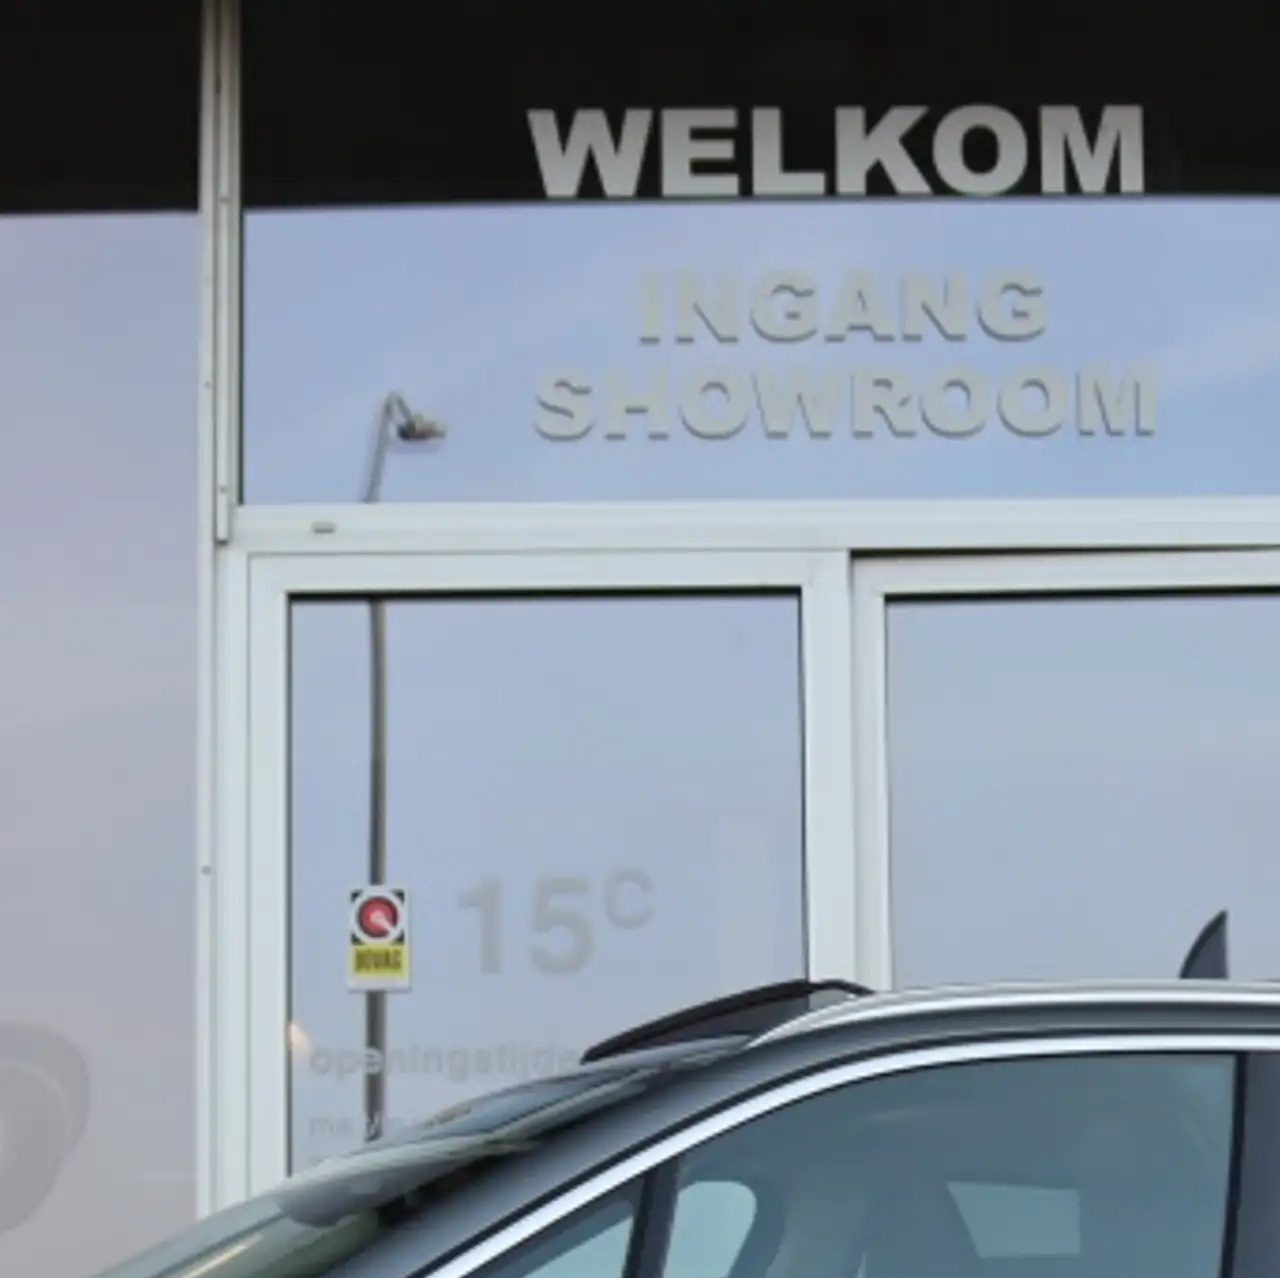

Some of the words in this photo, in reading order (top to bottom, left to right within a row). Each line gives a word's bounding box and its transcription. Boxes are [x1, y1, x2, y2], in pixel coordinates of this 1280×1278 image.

[526, 104, 1145, 198] WELKOM
[638, 267, 1047, 344] INGANG
[532, 361, 1161, 442] SHOWROOM
